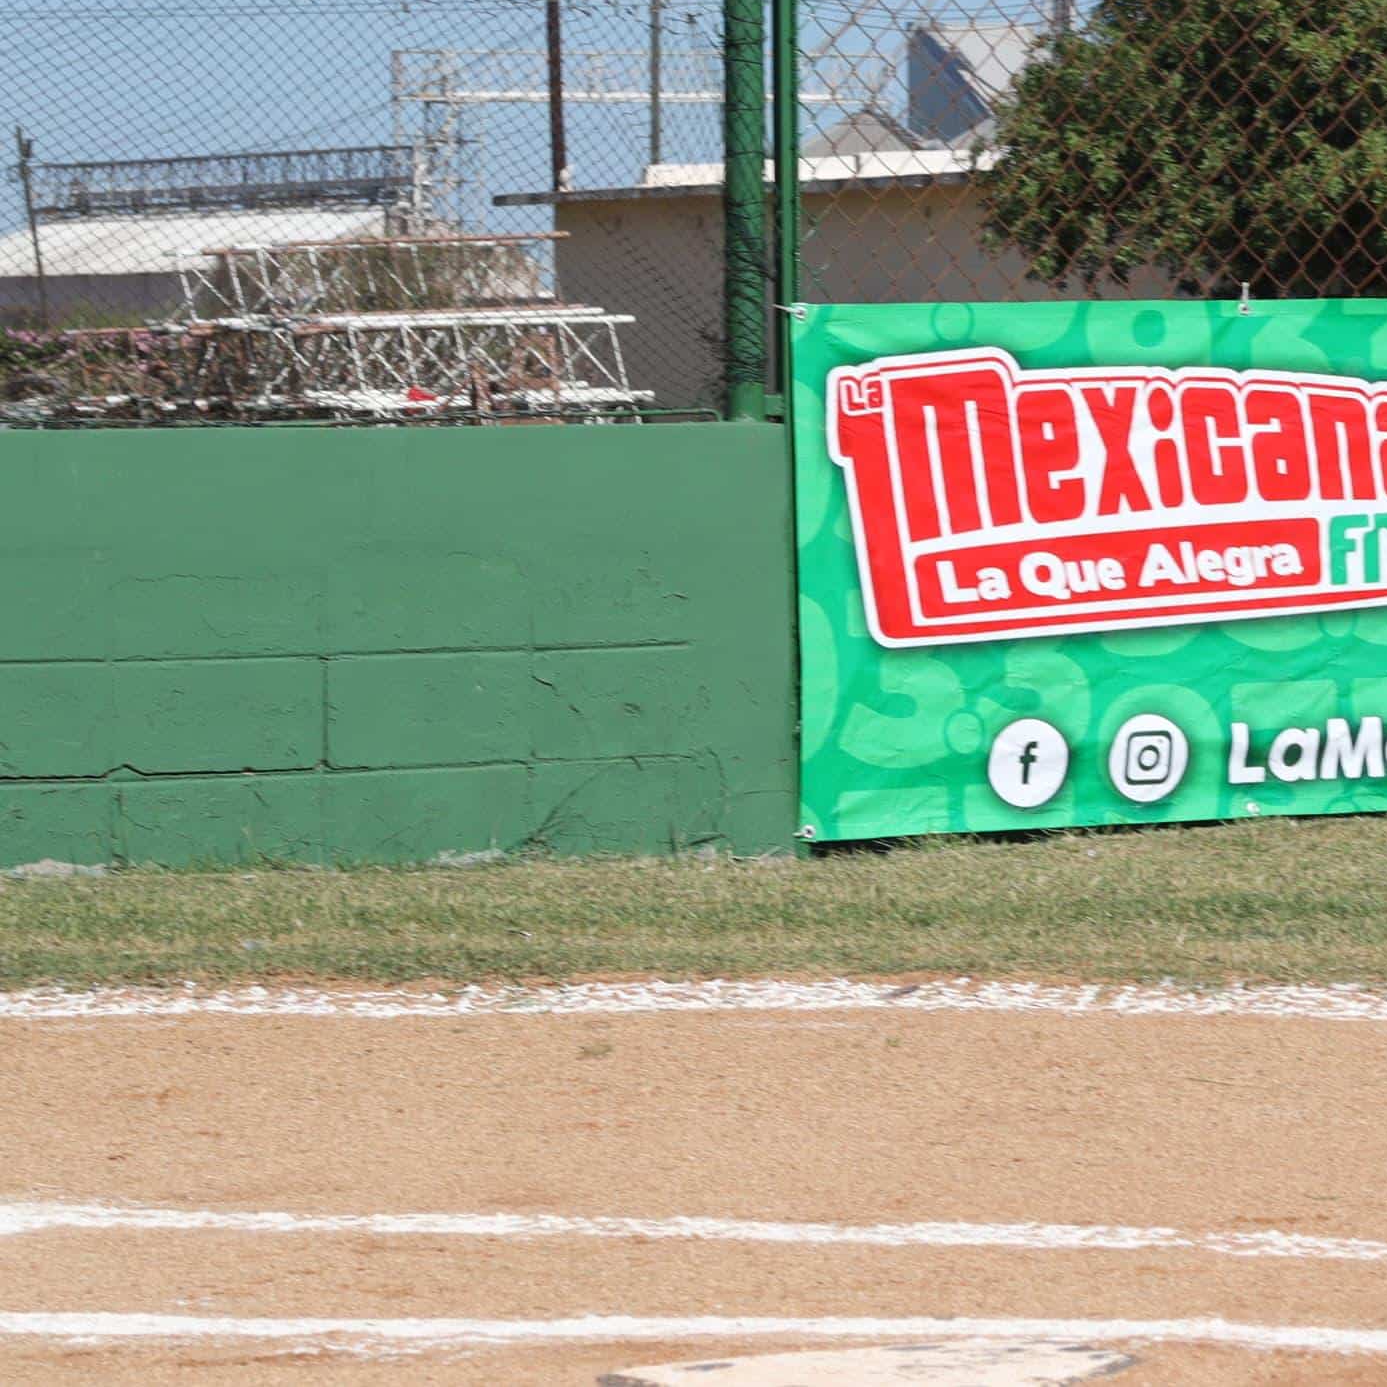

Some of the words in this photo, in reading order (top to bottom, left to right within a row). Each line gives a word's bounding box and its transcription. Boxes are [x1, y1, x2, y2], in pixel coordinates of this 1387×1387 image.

[839, 378, 884, 415] La
[936, 560, 1012, 604] La
[1019, 551, 1127, 600] Que
[1138, 539, 1304, 588] Alegra
